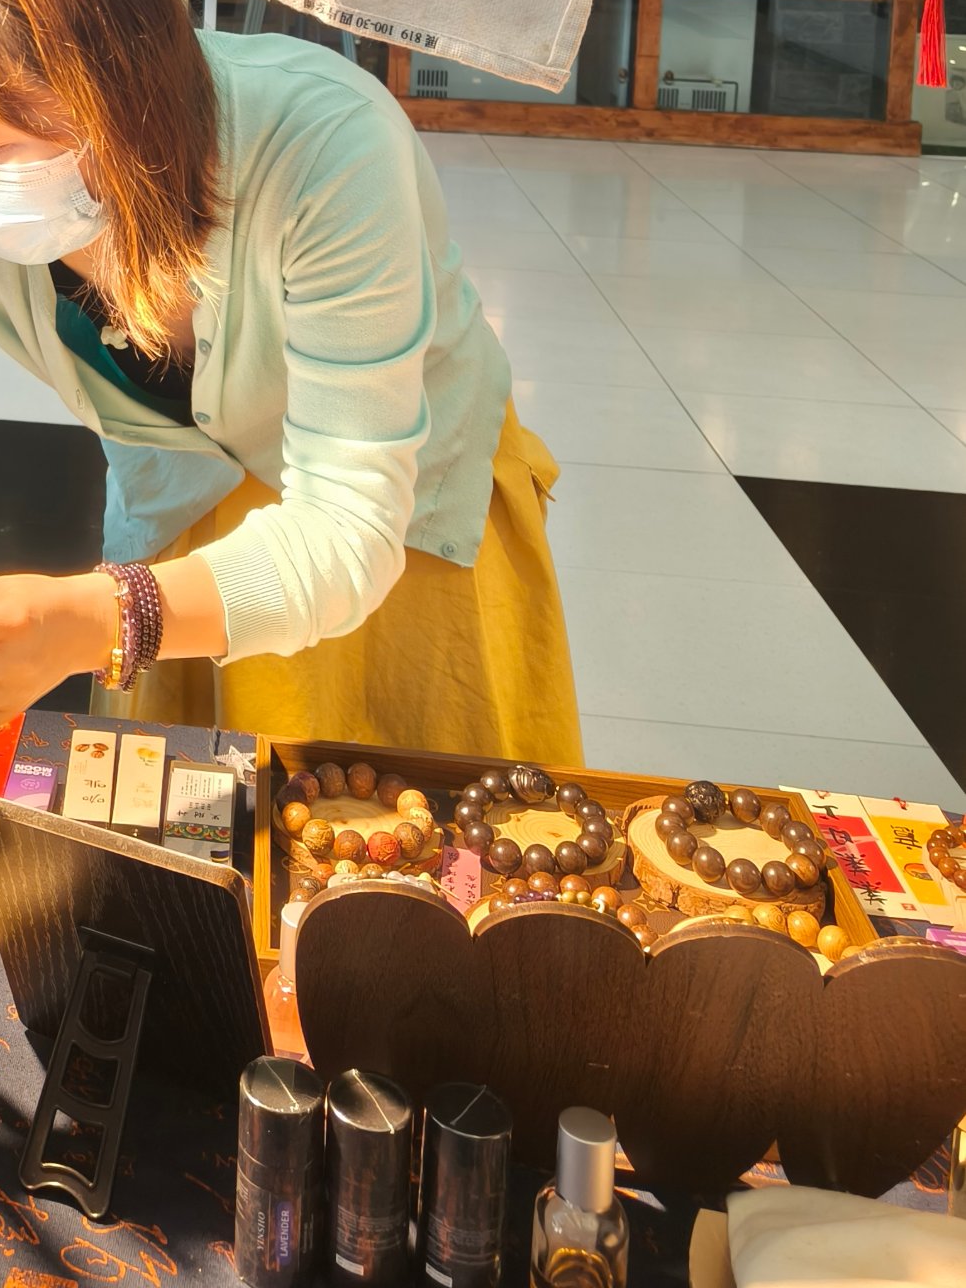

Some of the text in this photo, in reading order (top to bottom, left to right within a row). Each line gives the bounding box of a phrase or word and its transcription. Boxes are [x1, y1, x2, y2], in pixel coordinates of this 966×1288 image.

[355, 16, 395, 37] 100-30
[400, 28, 422, 43] 819
[280, 1210, 289, 1257] LAVENDER
